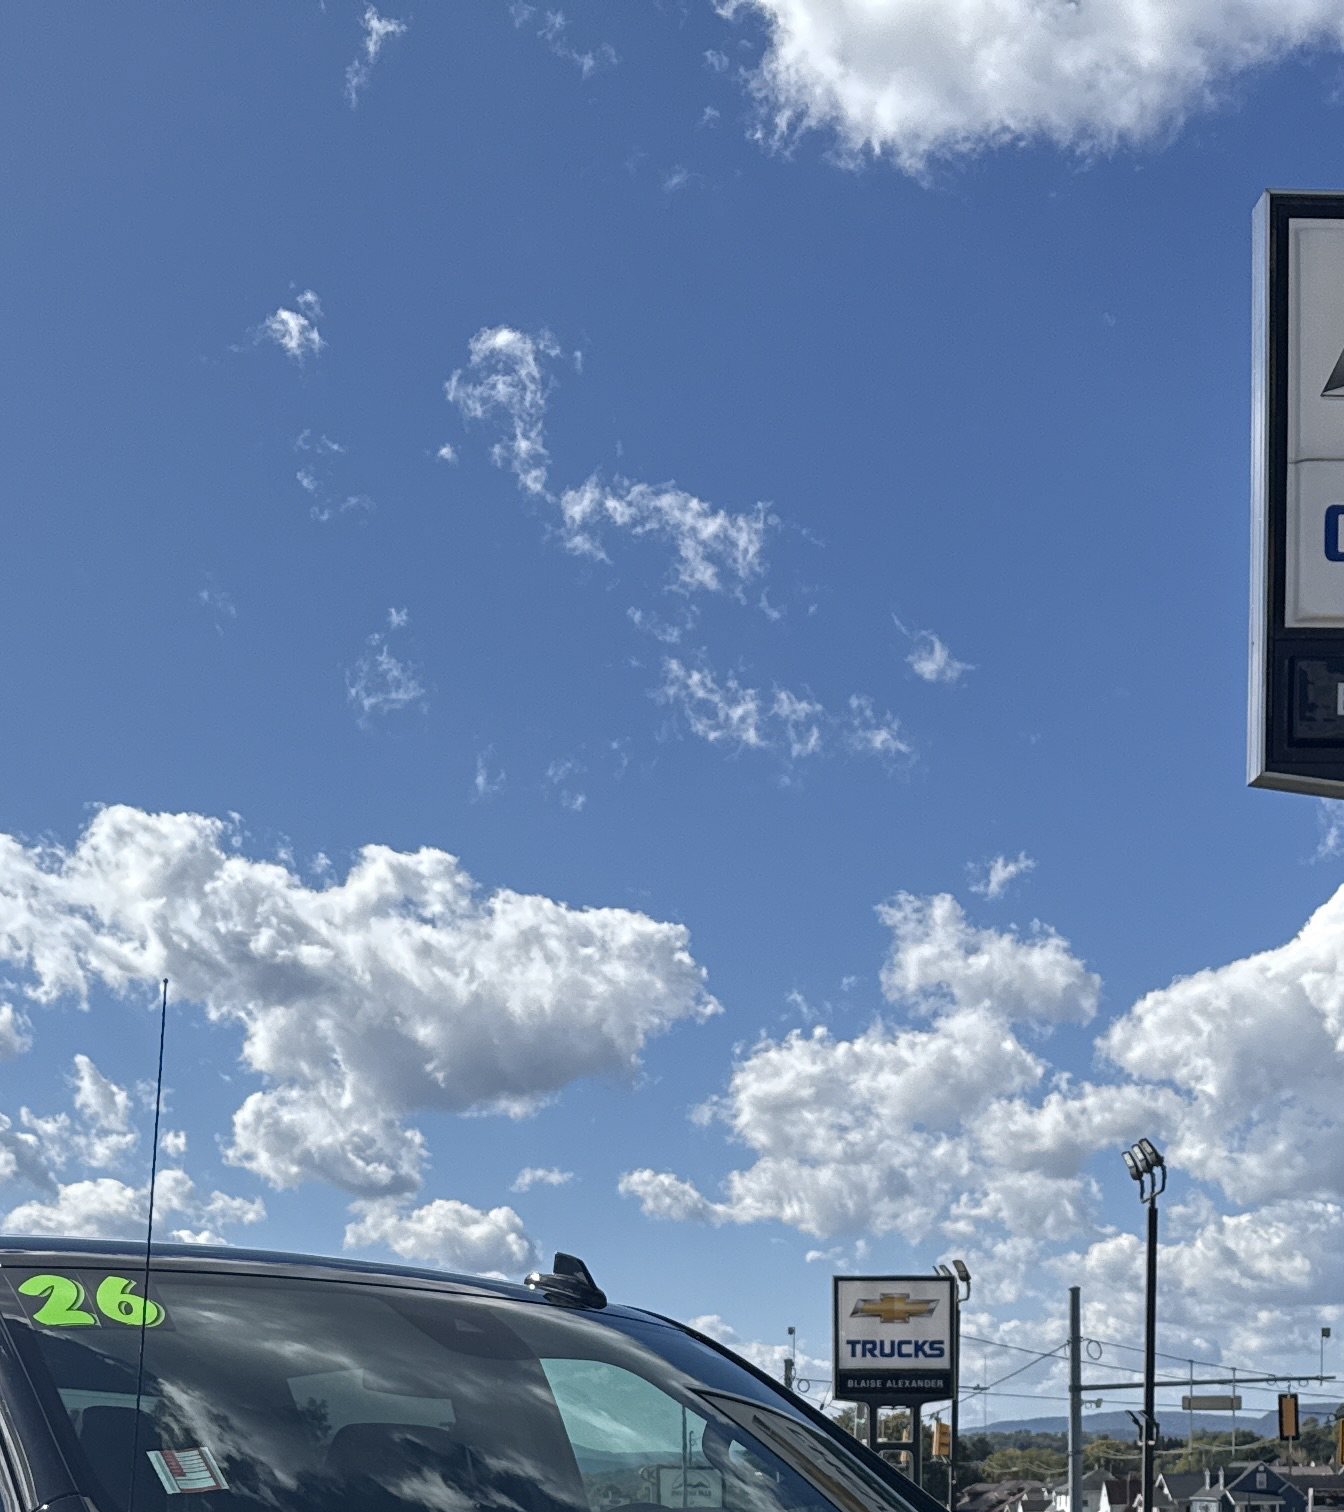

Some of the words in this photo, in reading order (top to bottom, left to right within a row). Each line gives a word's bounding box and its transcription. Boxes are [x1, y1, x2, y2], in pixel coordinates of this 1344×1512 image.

[17, 1273, 166, 1330] 26
[846, 1339, 945, 1358] TRUCKS
[847, 1379, 882, 1388] BLAISE
[886, 1379, 944, 1388] ALEXANDER
